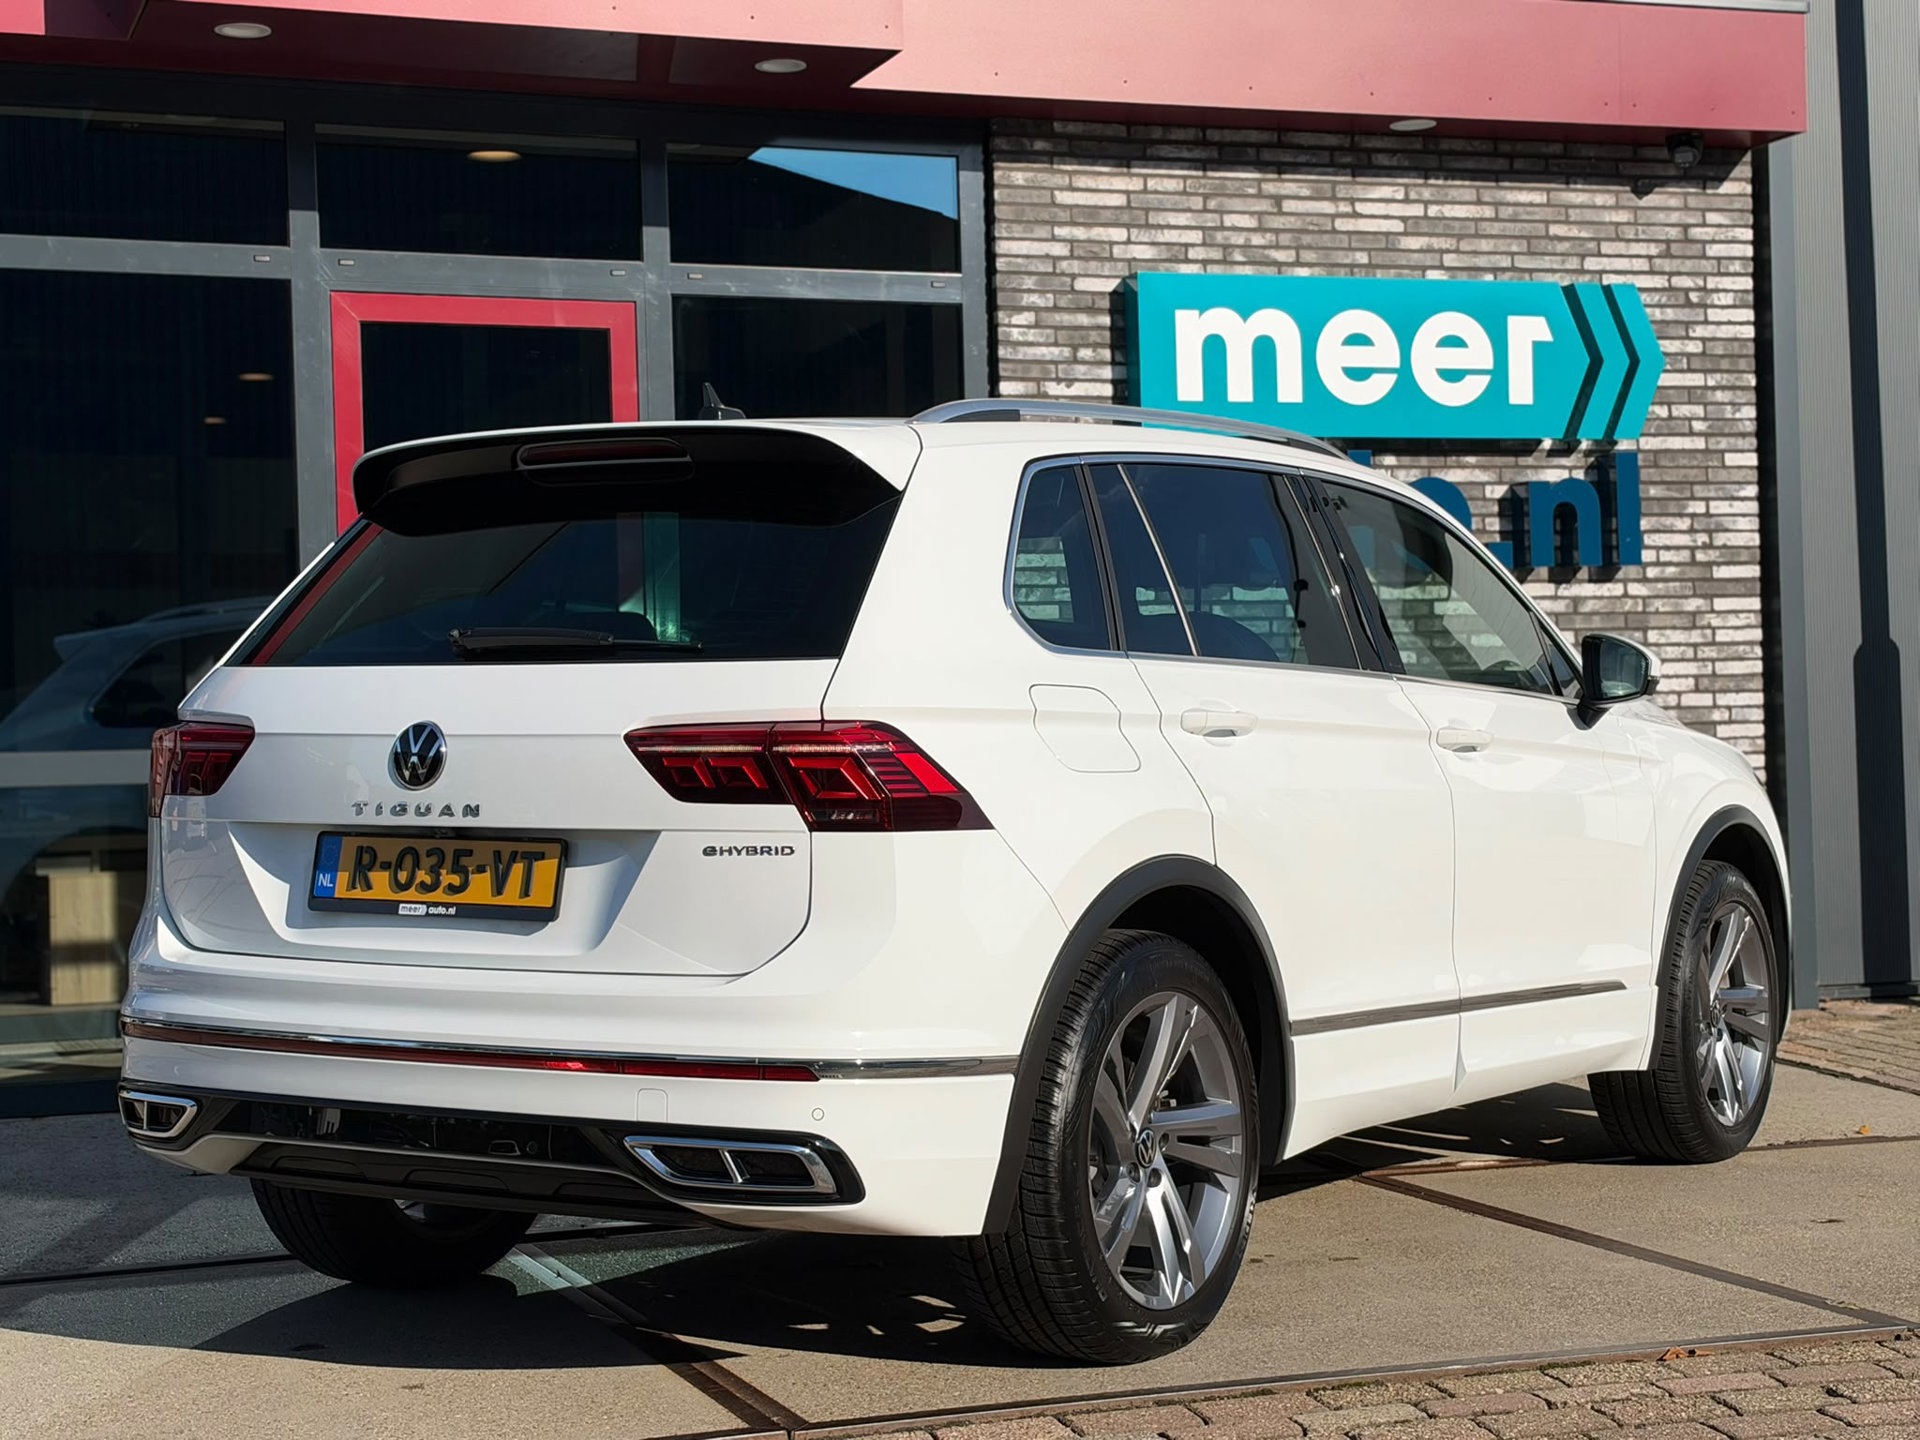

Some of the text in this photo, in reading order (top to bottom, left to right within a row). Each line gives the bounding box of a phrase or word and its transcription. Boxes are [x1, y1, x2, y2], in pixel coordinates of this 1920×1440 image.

[1175, 307, 1554, 406] meer
[351, 801, 480, 818] TIGUAN
[317, 873, 334, 888] NL
[347, 845, 546, 899] R-035-VT
[428, 905, 457, 915] auto.nl
